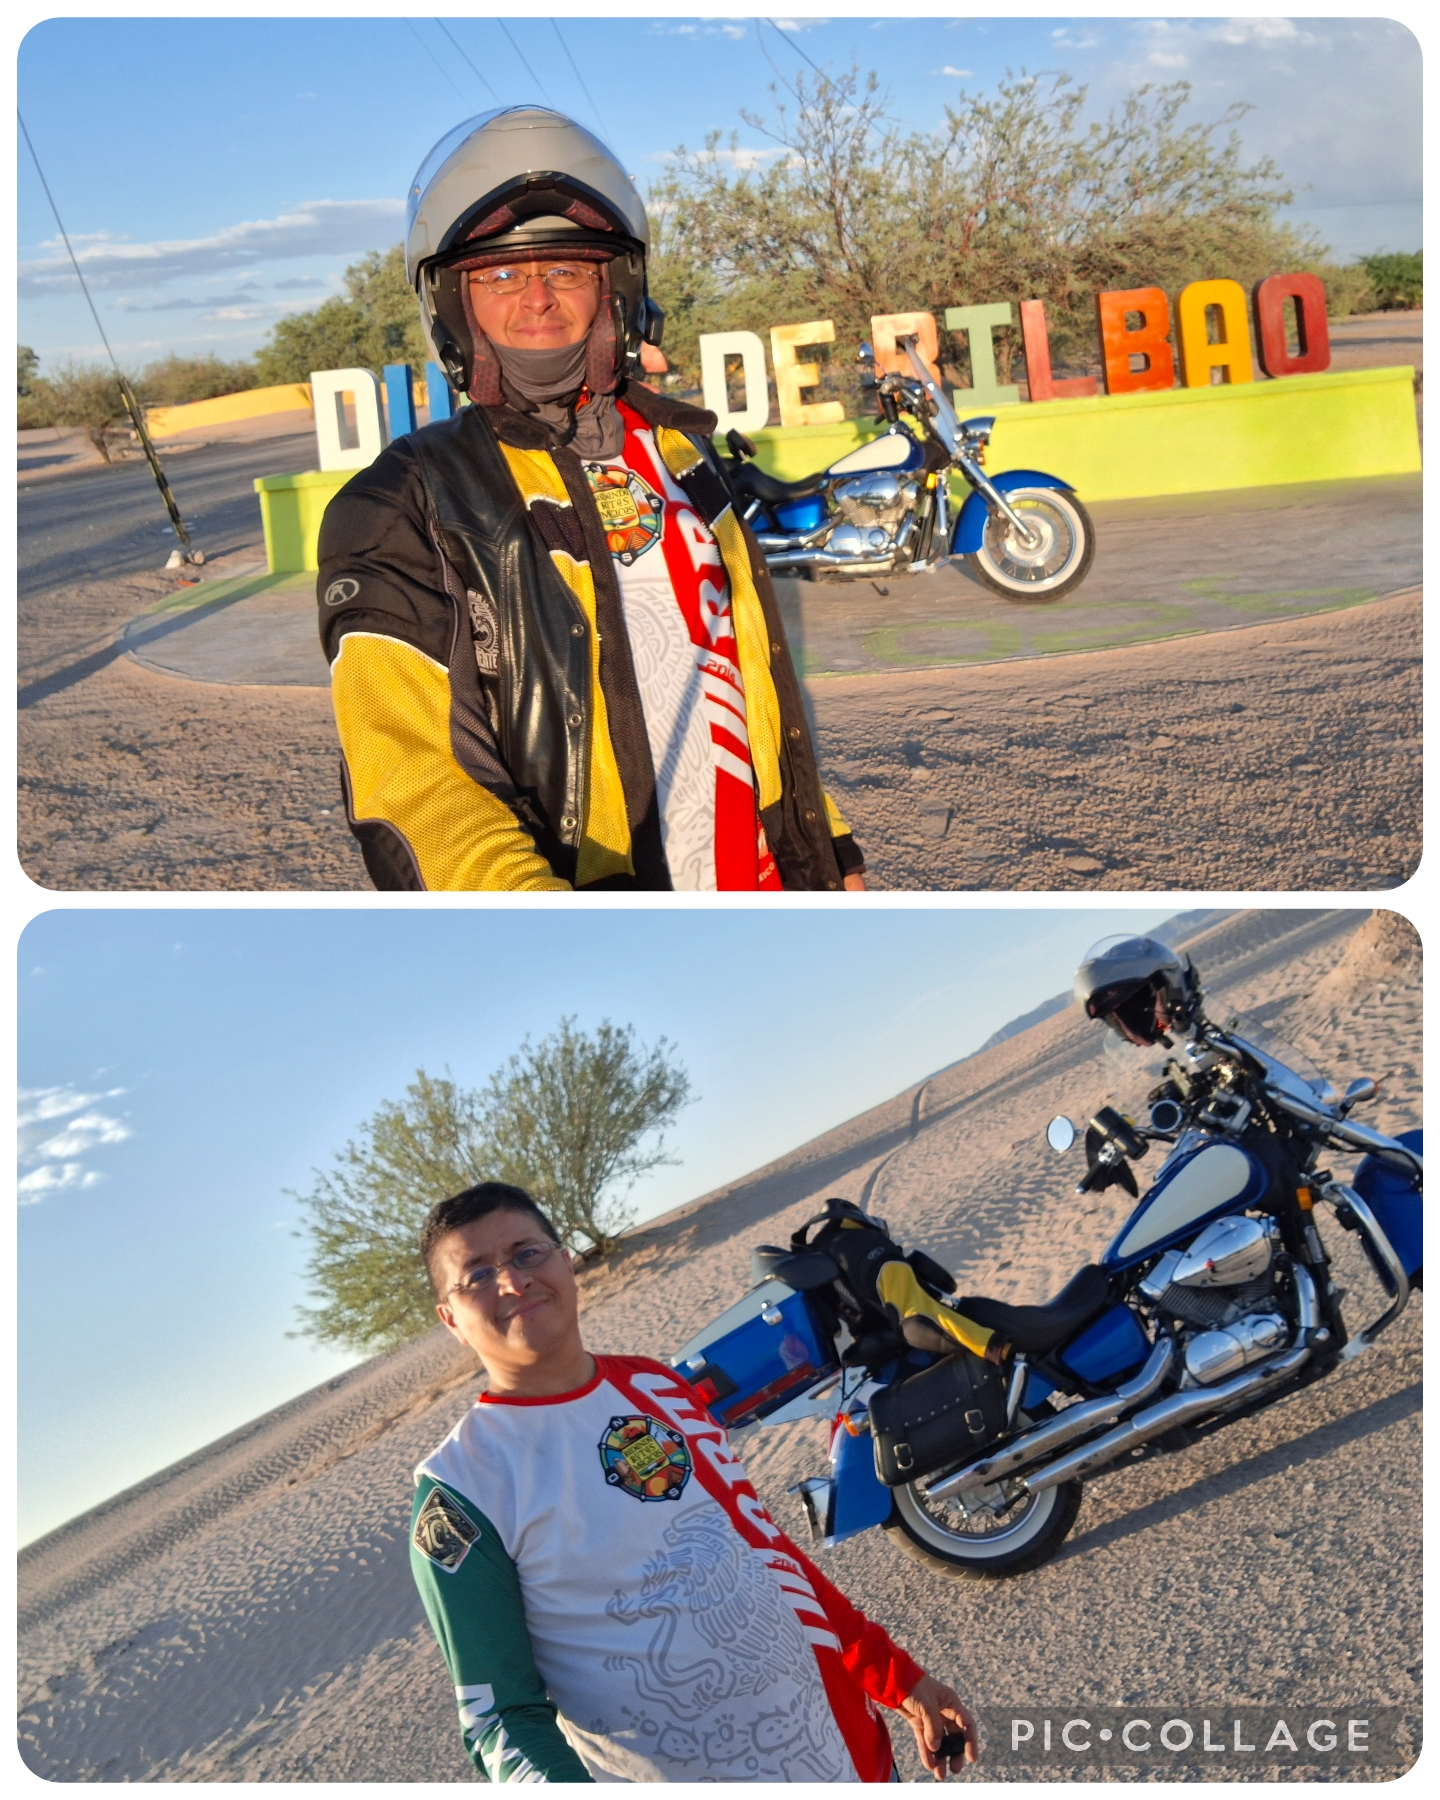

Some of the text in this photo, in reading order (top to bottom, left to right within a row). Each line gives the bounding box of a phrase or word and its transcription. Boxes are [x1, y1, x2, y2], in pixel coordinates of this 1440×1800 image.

[700, 272, 1331, 433] DE BILBAO
[622, 552, 633, 561] S
[612, 1418, 624, 1427] N
[668, 1487, 680, 1497] S
